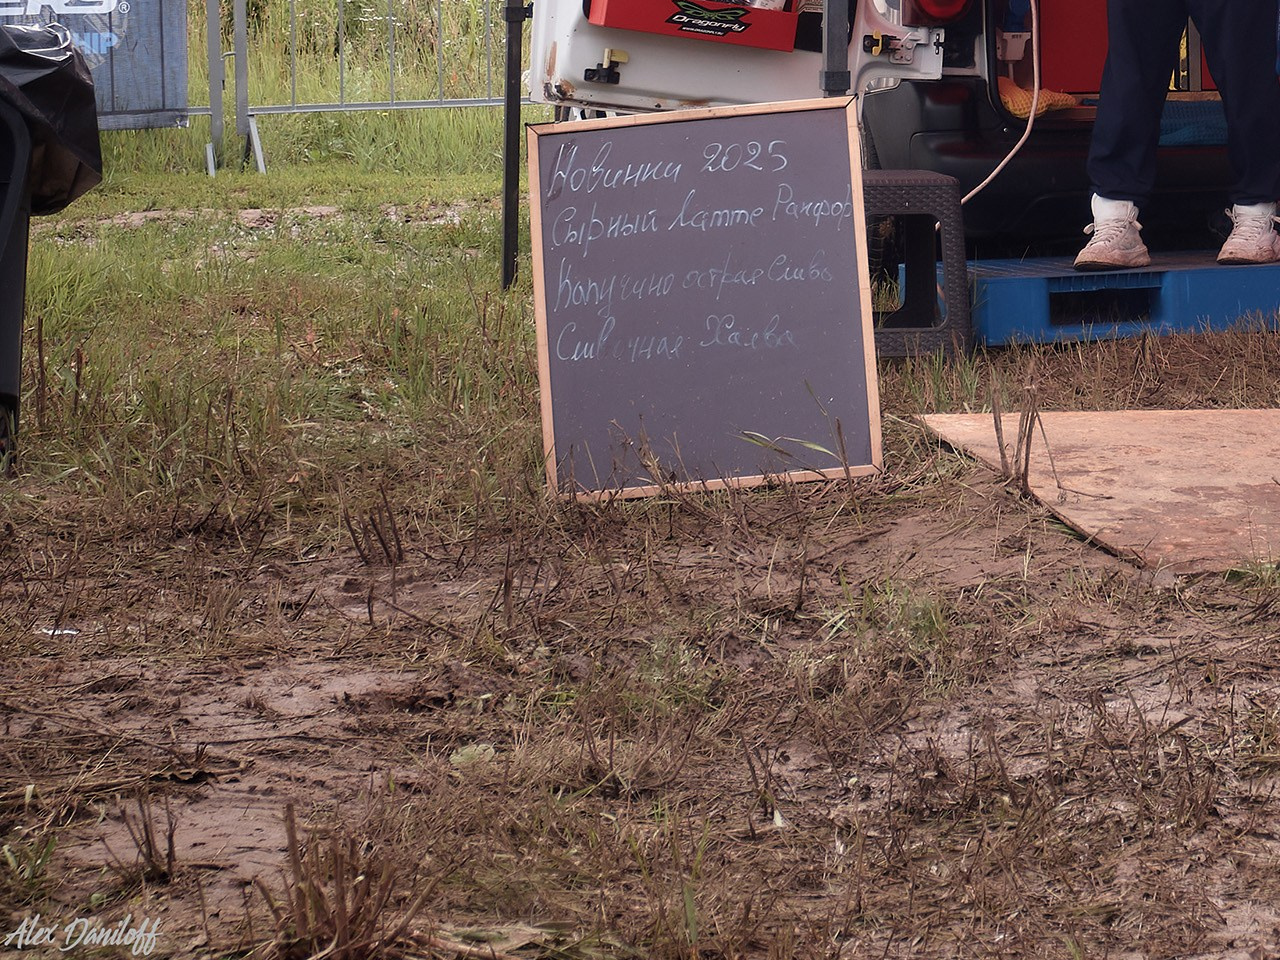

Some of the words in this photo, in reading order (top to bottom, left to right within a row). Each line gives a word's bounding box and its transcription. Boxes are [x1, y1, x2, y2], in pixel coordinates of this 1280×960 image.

[672, 14, 746, 32] Dragonfly
[547, 141, 682, 198] Новинки
[700, 140, 788, 173] 2025
[551, 202, 659, 258] Сырный
